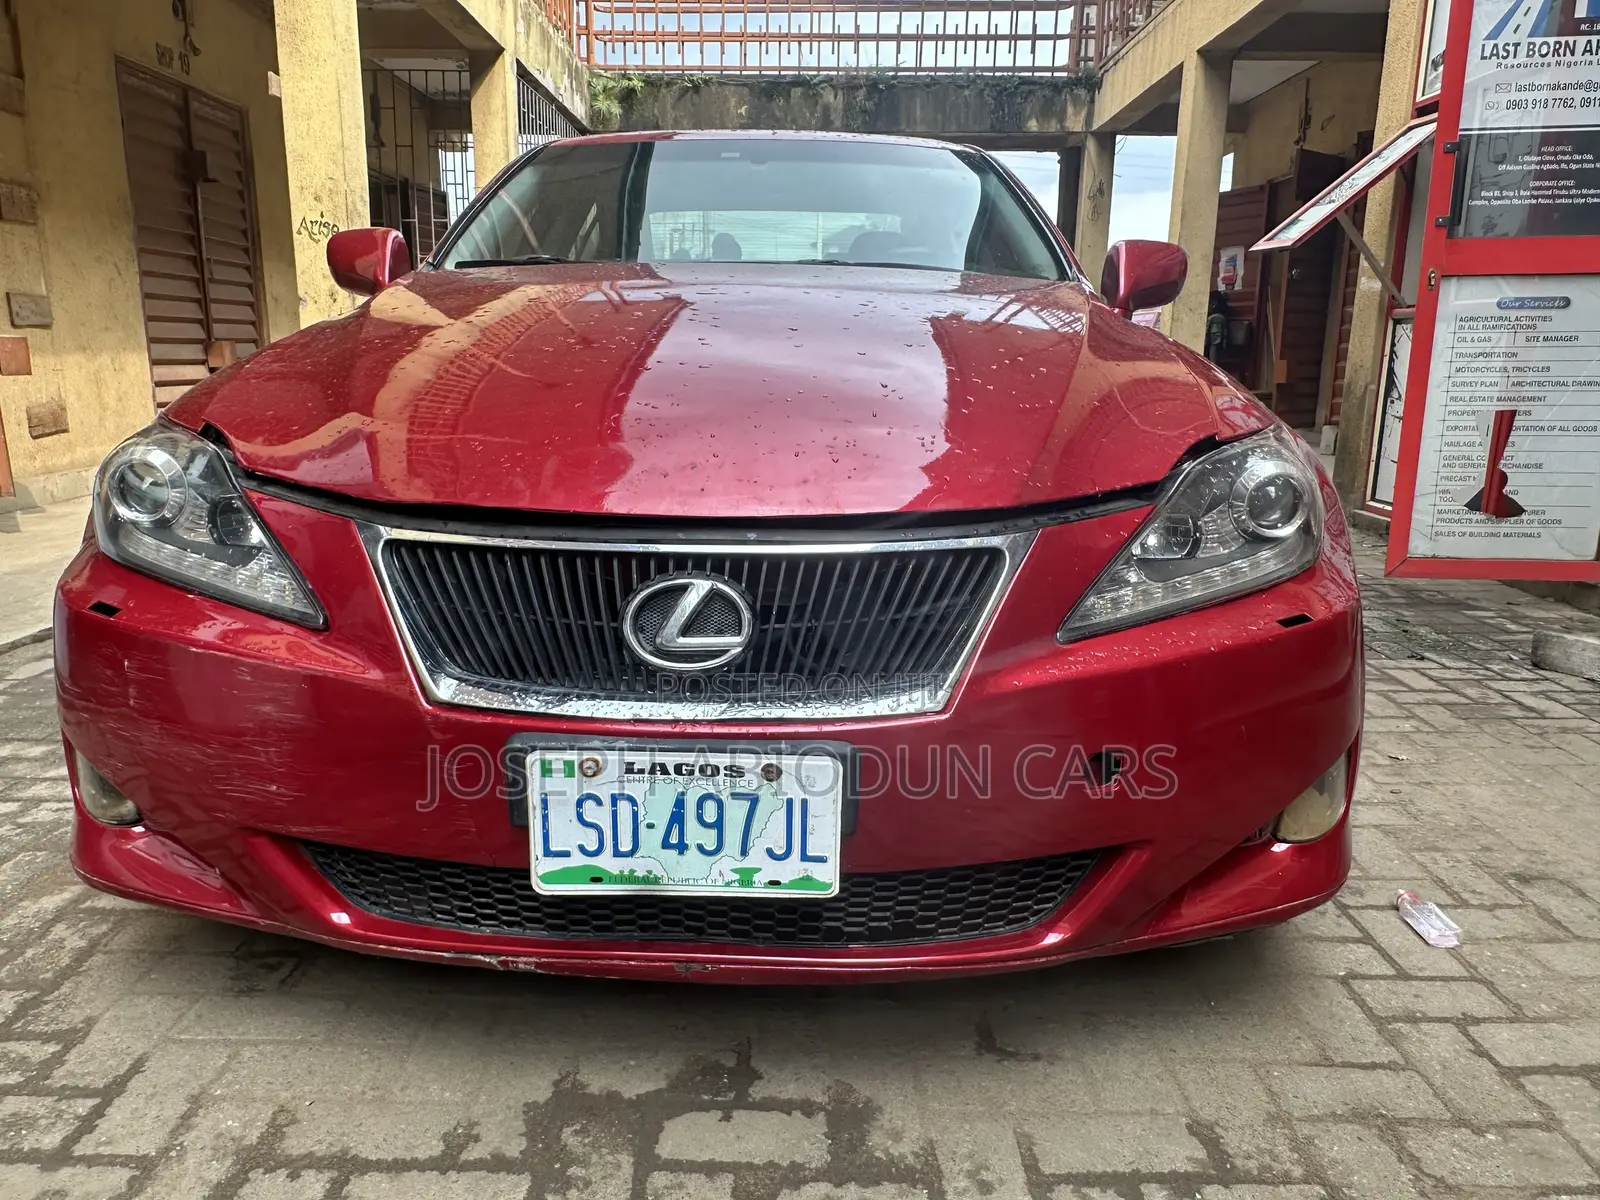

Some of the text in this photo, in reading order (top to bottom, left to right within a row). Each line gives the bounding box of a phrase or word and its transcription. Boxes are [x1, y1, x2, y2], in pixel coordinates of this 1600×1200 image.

[1480, 42, 1521, 60] LAST
[1526, 40, 1577, 58] BORN
[179, 50, 190, 76] 19
[1496, 61, 1551, 69] Resources
[1555, 59, 1593, 68] Nigeria
[1506, 98, 1528, 110] 0903
[1531, 97, 1549, 109] 918
[1551, 97, 1577, 110] 7762,
[1501, 299, 1521, 307] Our
[624, 761, 746, 778] LAGOS
[616, 775, 754, 788] CENTRE OF EXCELLENCE
